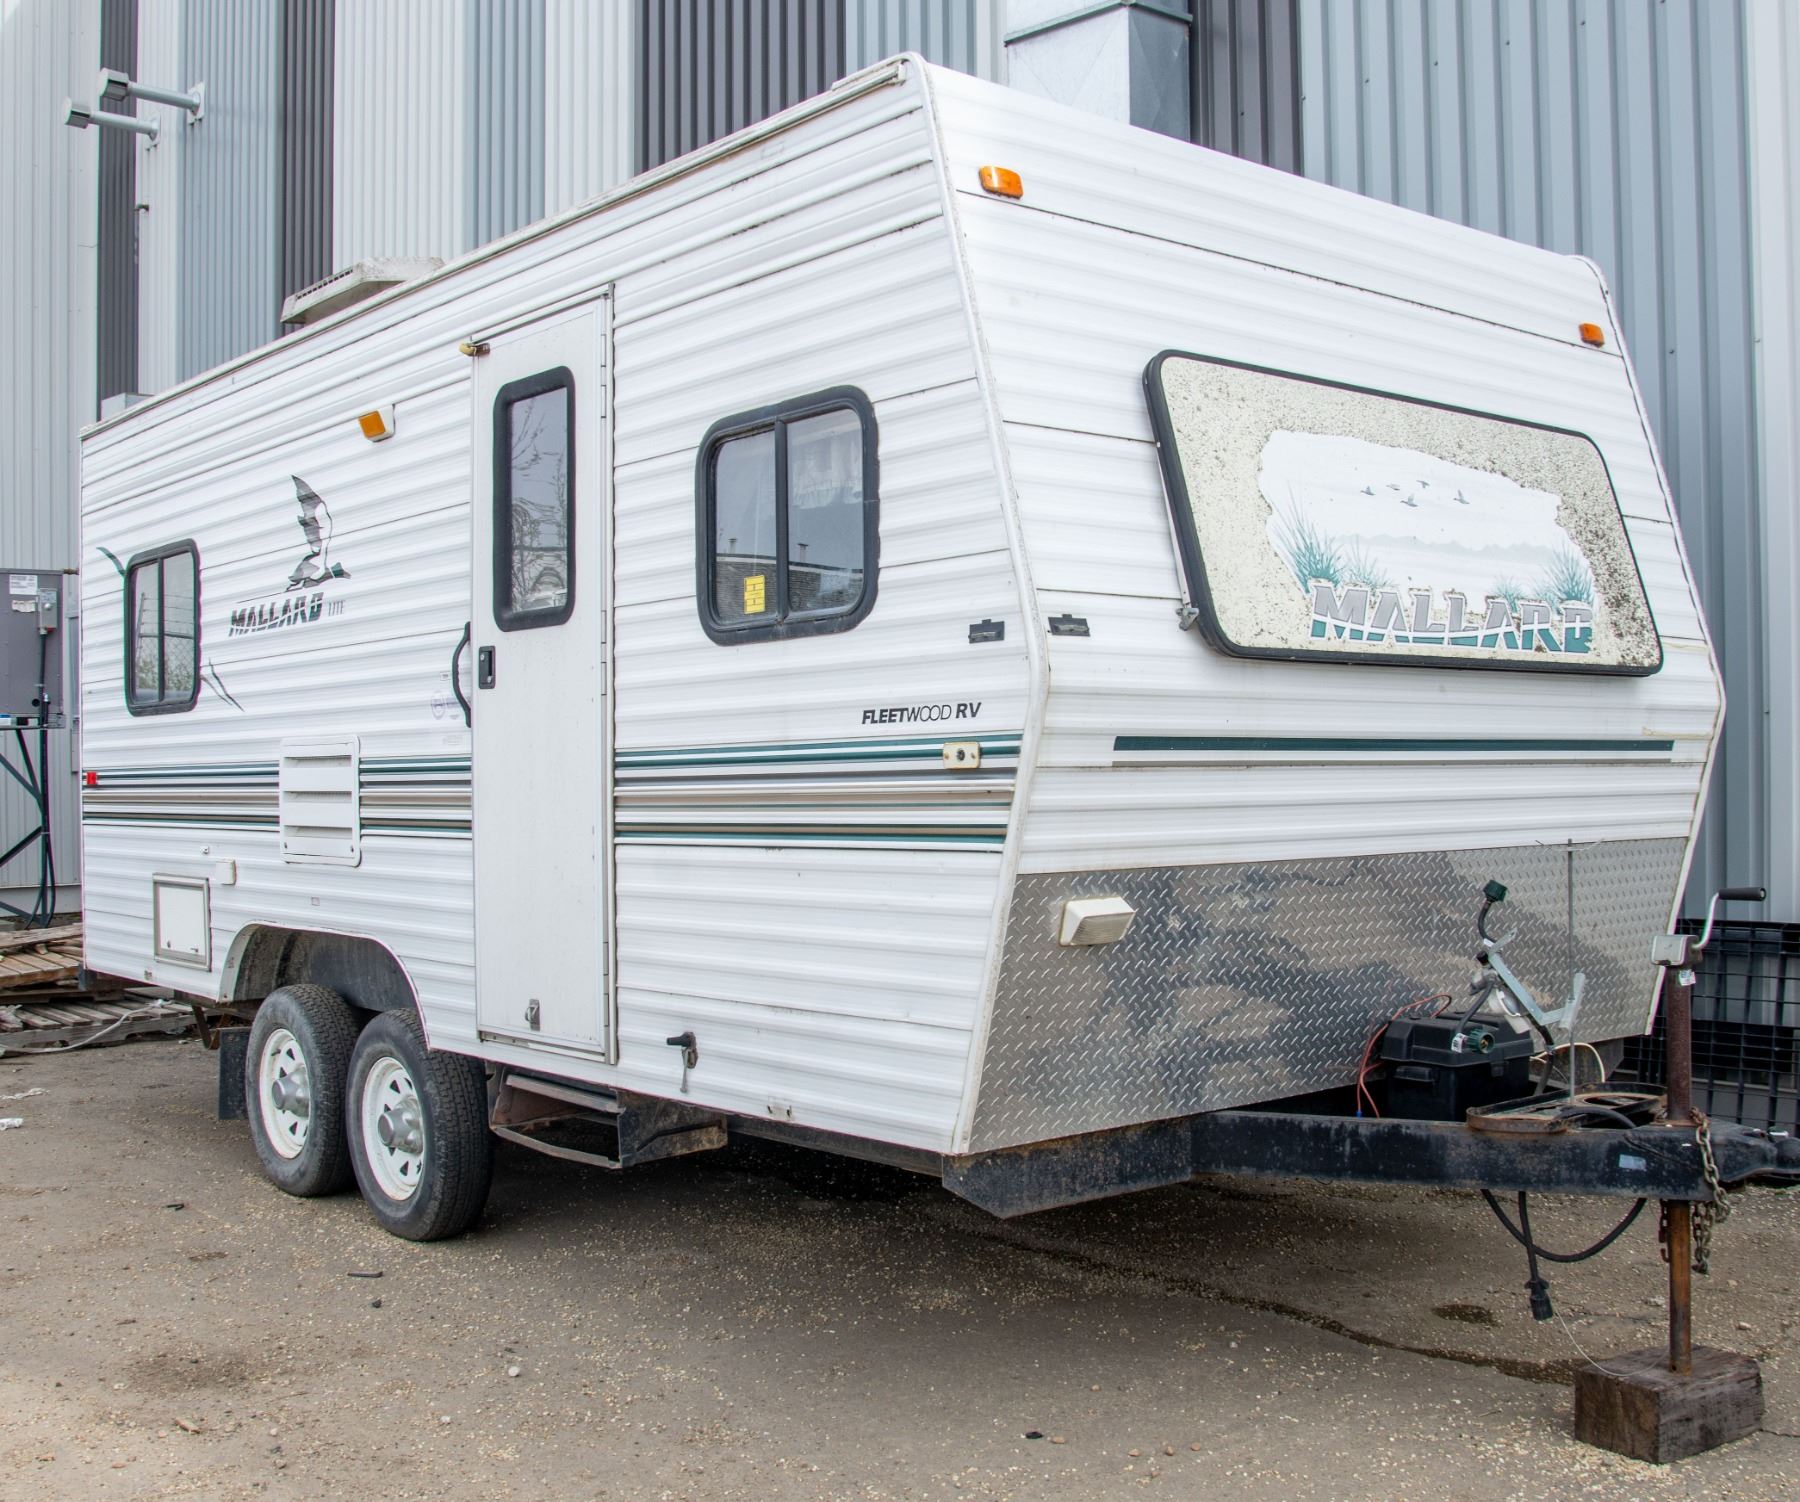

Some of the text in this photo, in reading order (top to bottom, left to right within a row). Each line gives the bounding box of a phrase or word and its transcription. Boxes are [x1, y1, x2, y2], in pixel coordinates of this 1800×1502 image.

[228, 591, 324, 636] MALLARD
[1308, 581, 1594, 654] MALLARD
[861, 702, 982, 725] FLEETWOOD RV
